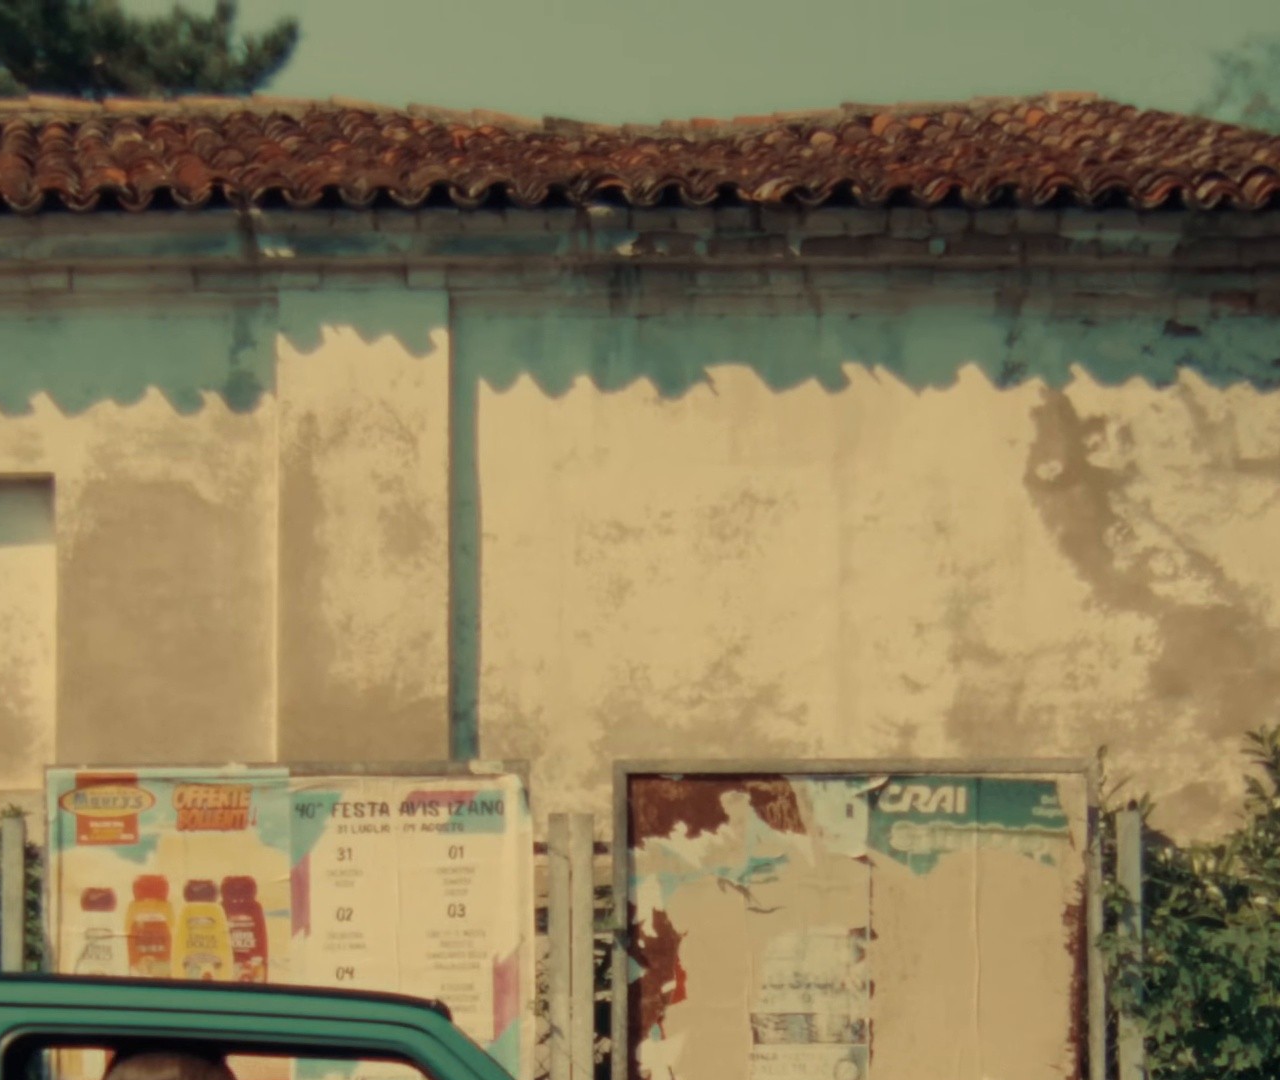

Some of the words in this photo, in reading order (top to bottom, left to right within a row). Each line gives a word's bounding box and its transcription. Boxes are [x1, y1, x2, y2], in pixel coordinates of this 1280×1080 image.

[878, 784, 966, 813] CRAI
[331, 801, 391, 818] FESTA
[399, 800, 440, 818] AVIS
[448, 799, 505, 817] IZANO
[351, 824, 391, 835] LUGLIO
[336, 847, 354, 862] 31
[448, 845, 465, 861] 01
[336, 906, 354, 922] 02
[447, 902, 467, 918] 03
